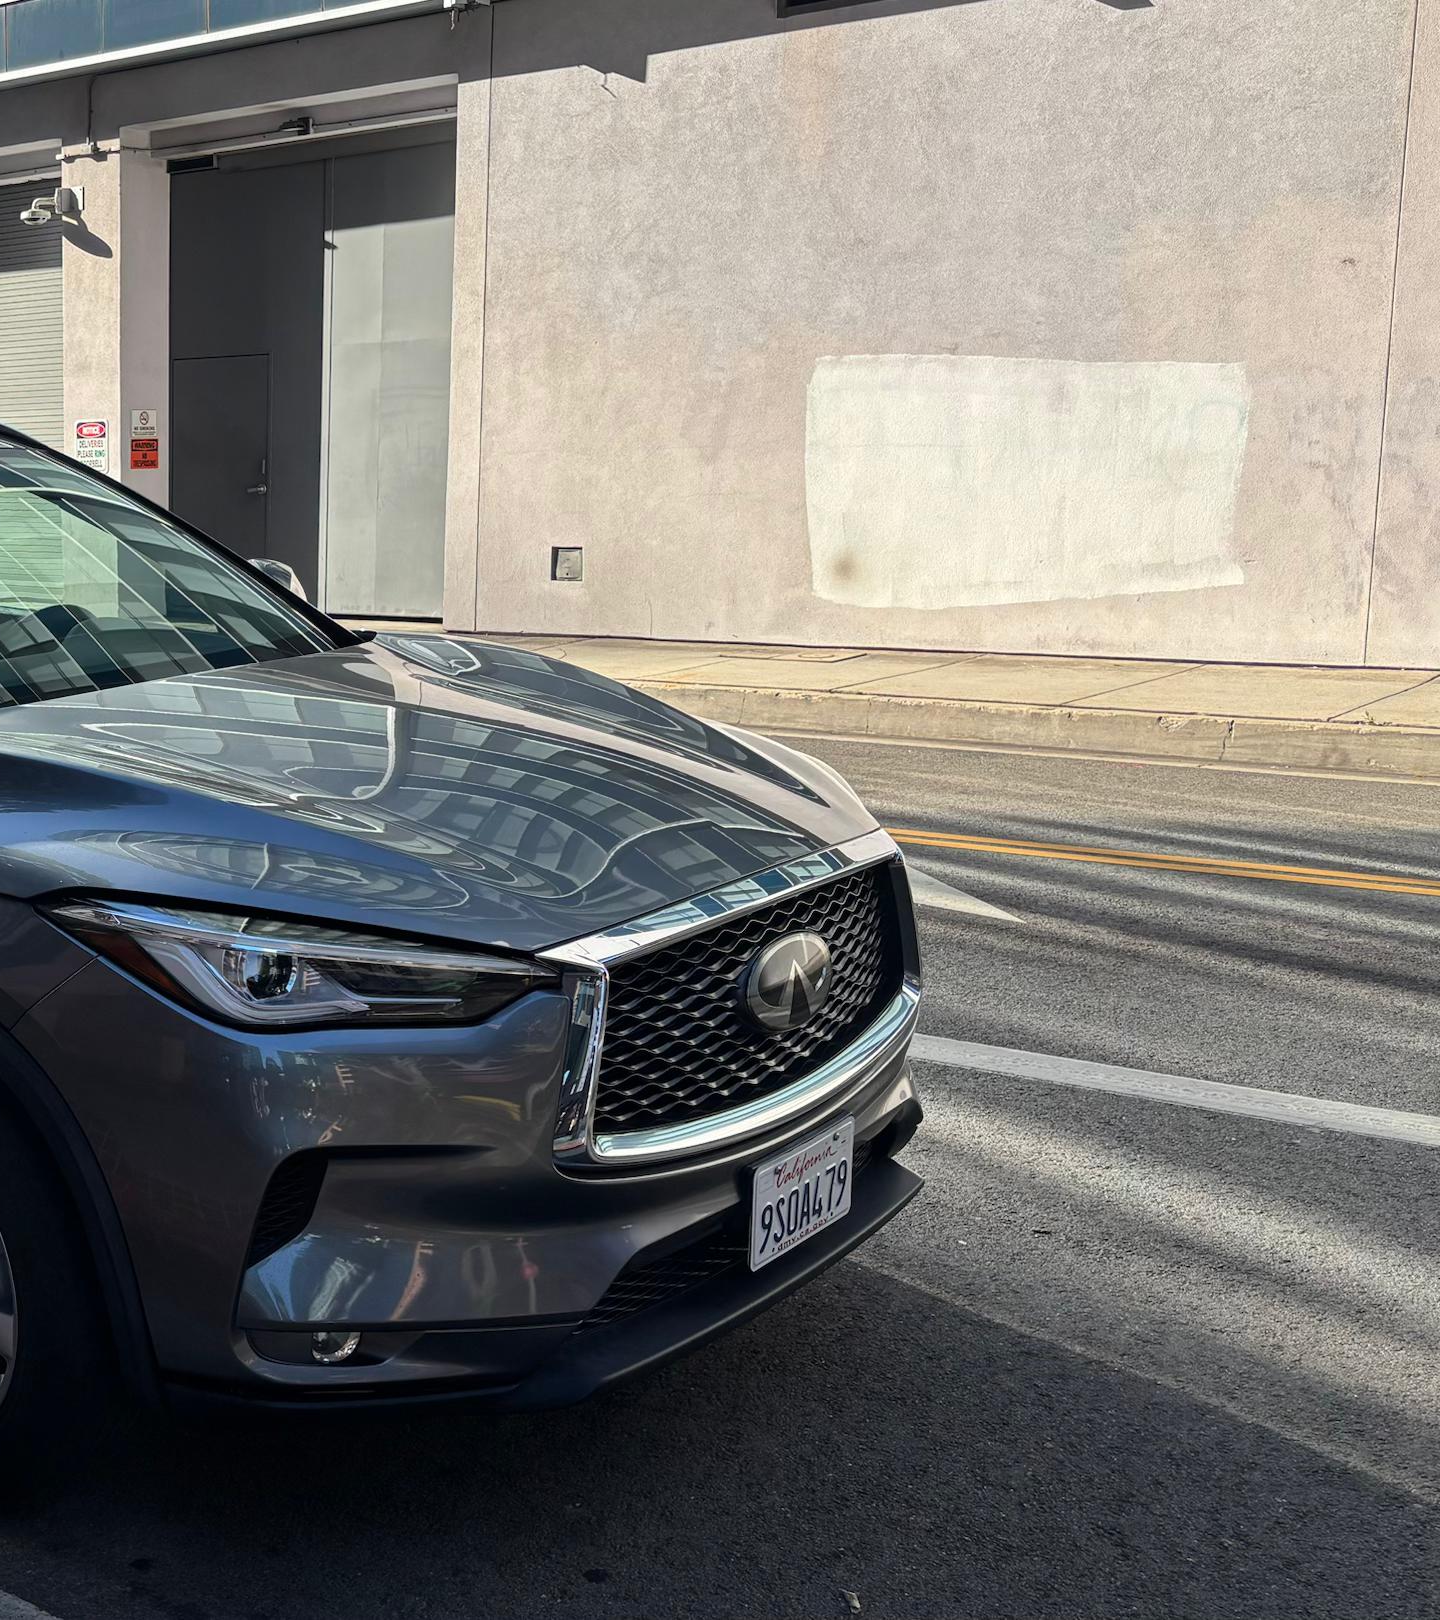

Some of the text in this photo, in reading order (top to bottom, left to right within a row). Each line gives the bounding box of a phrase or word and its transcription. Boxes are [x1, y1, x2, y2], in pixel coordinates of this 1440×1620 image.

[77, 450, 105, 458] PLEASE RING
[79, 440, 103, 448] DELIVERIES
[775, 1143, 839, 1189] California
[760, 1158, 848, 1254] 9SOA479
[777, 1217, 829, 1251] dmv.ca.gov
